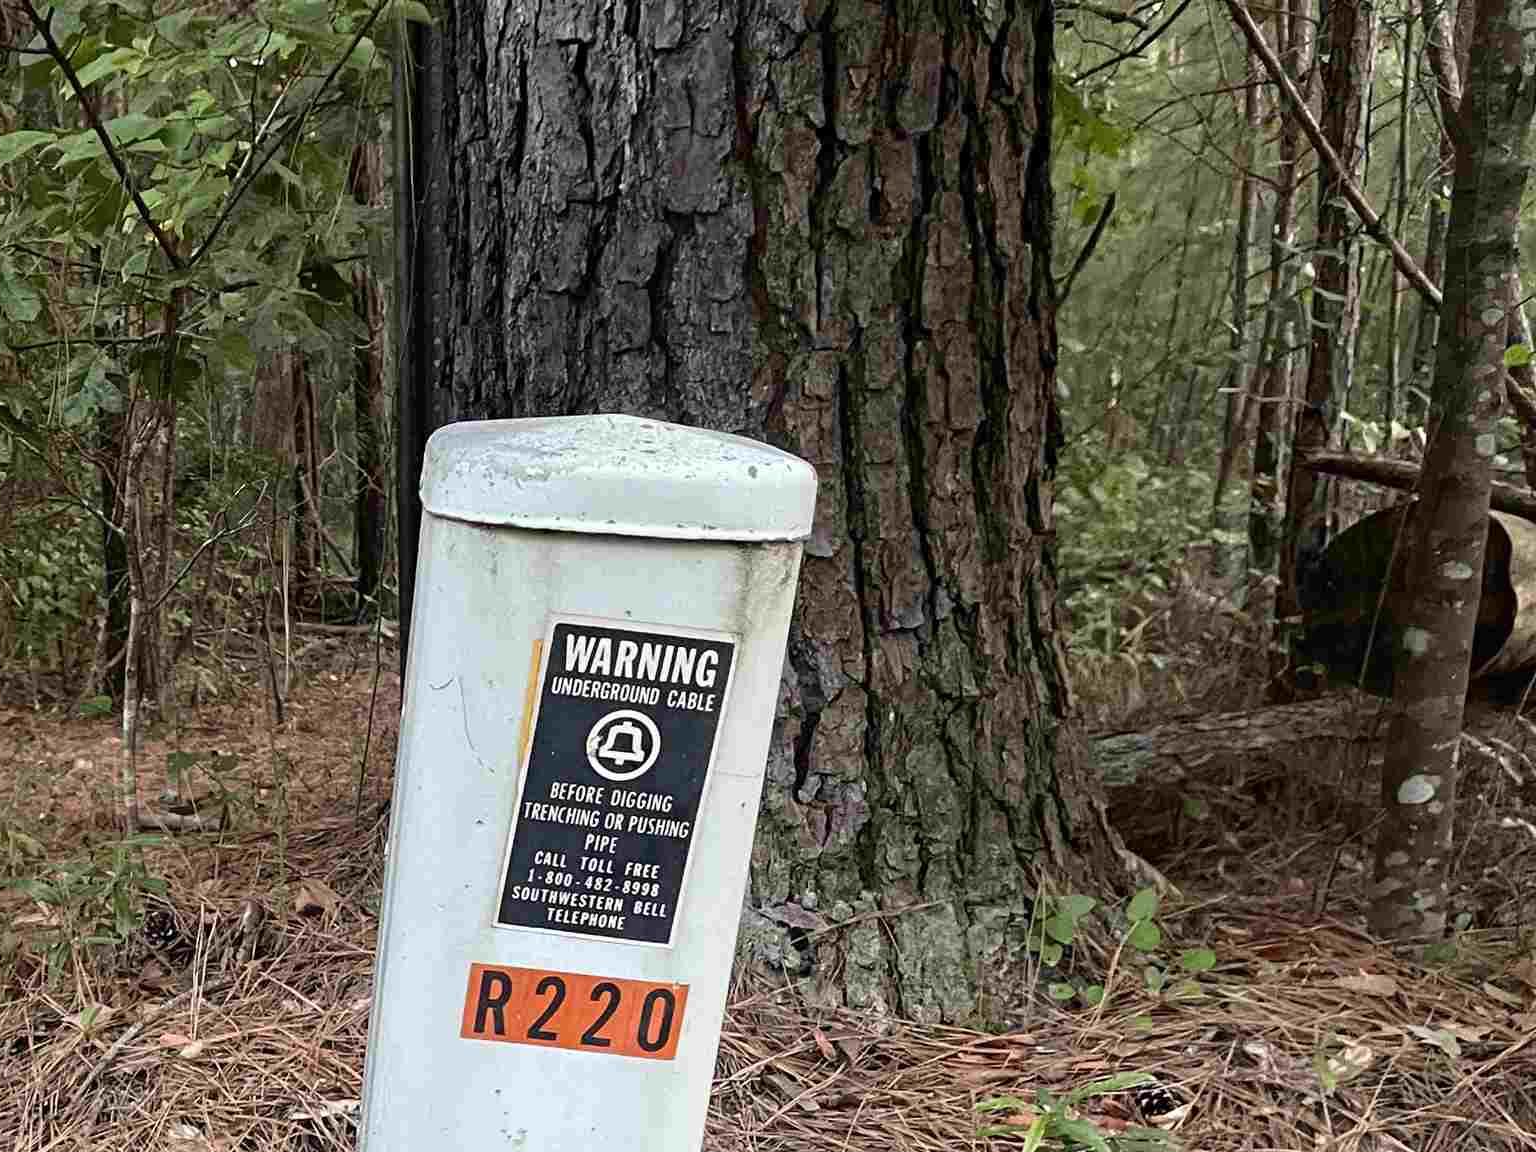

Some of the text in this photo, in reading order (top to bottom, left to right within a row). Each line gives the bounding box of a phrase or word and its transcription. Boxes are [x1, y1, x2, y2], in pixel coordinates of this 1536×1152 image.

[565, 633, 719, 688] WARNING
[551, 676, 715, 712] UNDERGROUND CABLE
[550, 782, 673, 812] BEFORE DIGGING
[524, 802, 690, 839] TRENCHING OR PUSHING
[584, 834, 618, 853] PIPE
[534, 851, 660, 879] CALL TOLL FREE
[511, 886, 667, 917] SOUTHWESTERN BELL
[548, 908, 626, 930] TELEPHONE
